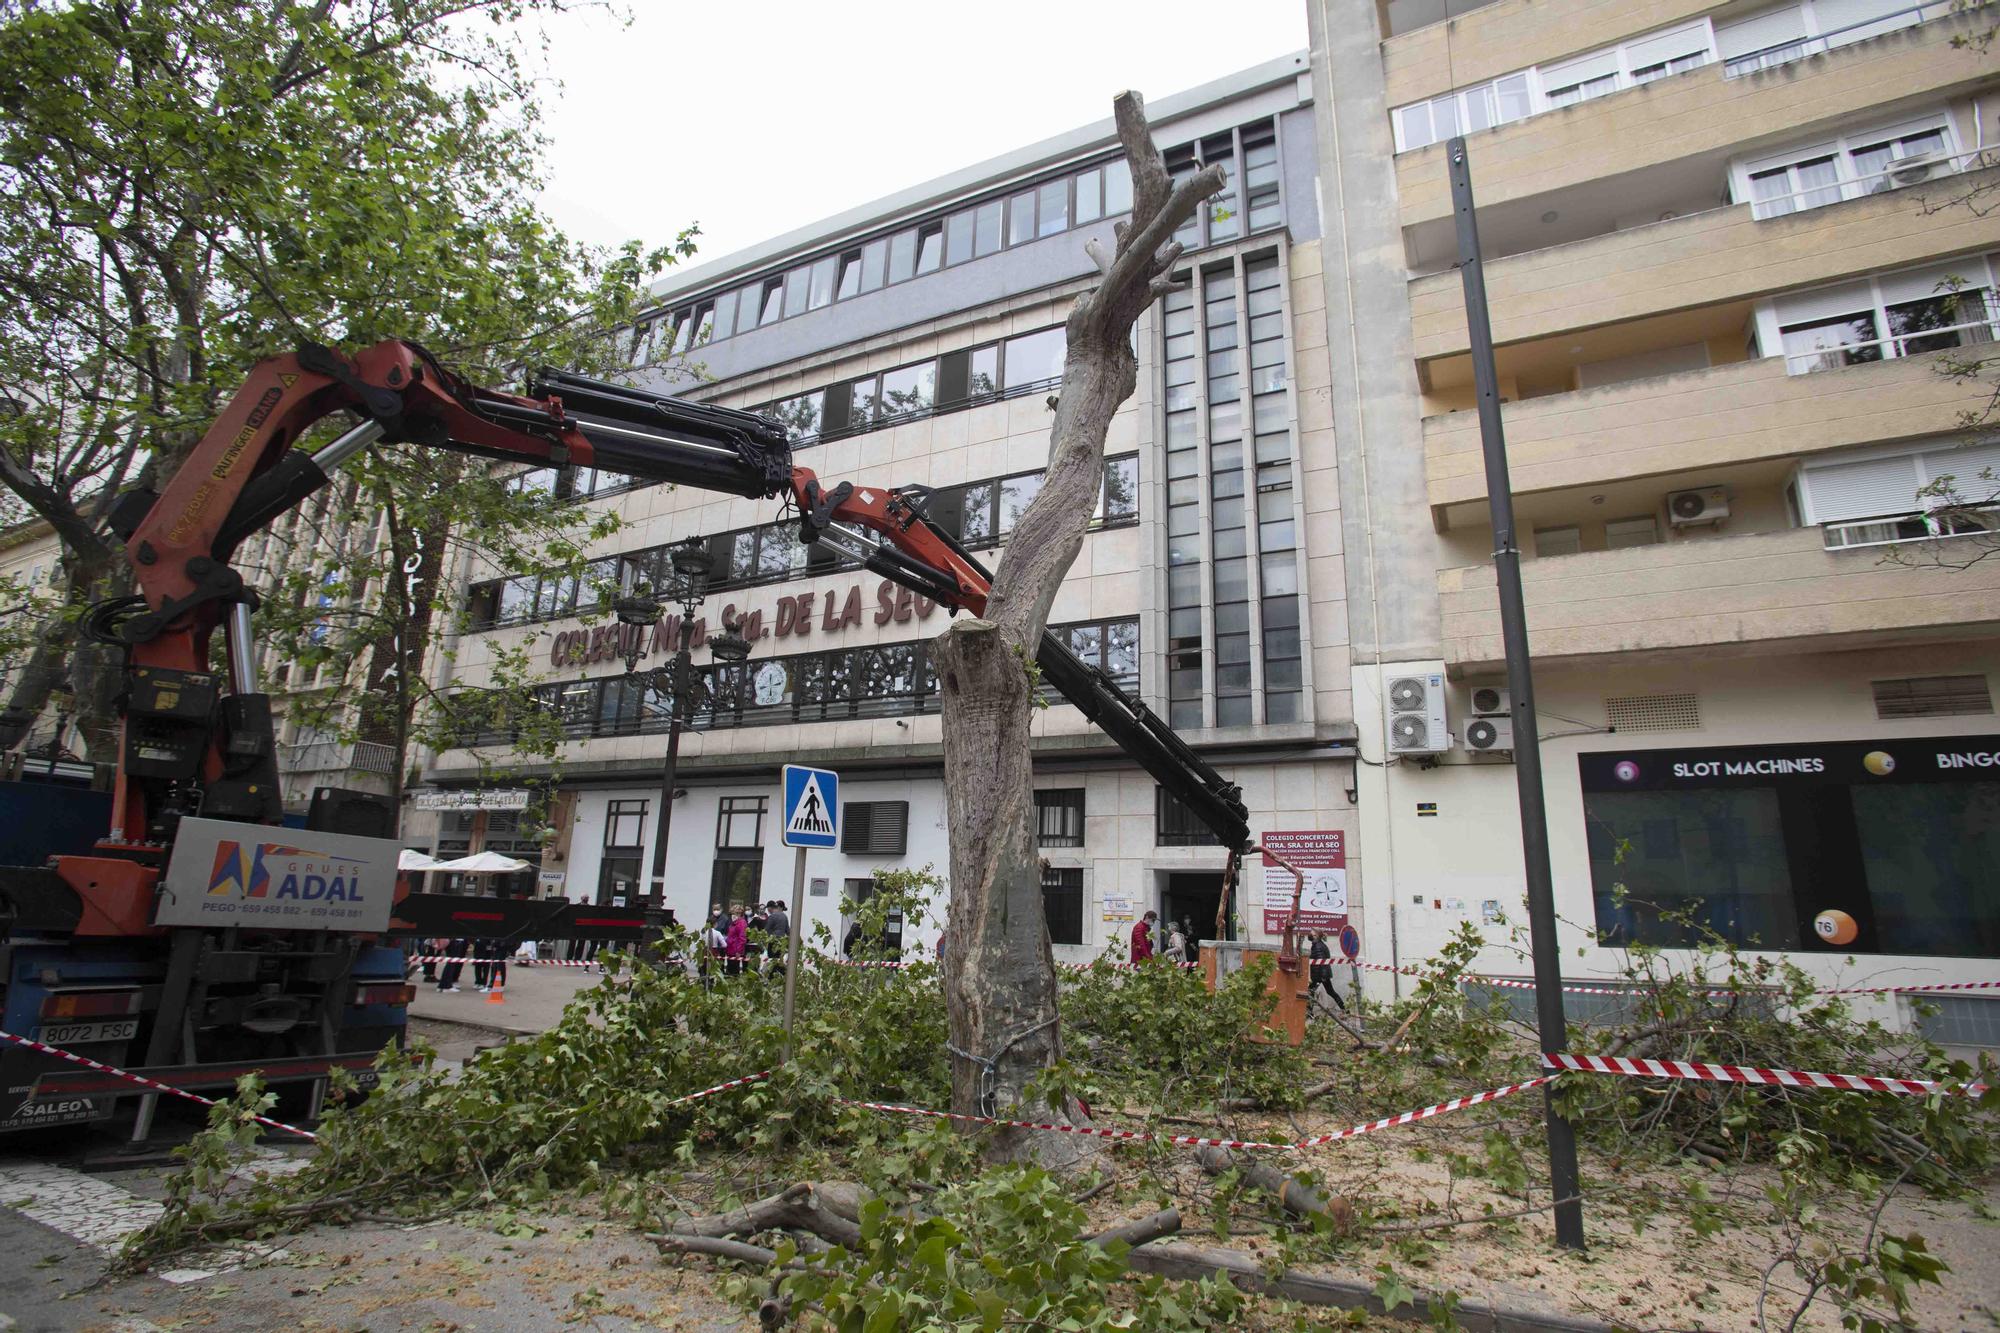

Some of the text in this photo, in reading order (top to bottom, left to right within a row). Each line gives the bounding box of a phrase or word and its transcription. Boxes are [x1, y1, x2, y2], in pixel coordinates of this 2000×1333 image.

[212, 427, 254, 480] PALFINGER
[774, 592, 815, 638] DE
[821, 584, 862, 632] LA
[1673, 758, 1825, 777] SLOT MACHINES
[288, 862, 359, 876] GRUES
[276, 874, 364, 902] ADAL
[201, 902, 236, 913] PEGO
[46, 1023, 134, 1043] 8072 FSC
[22, 1101, 82, 1117] SALEO
